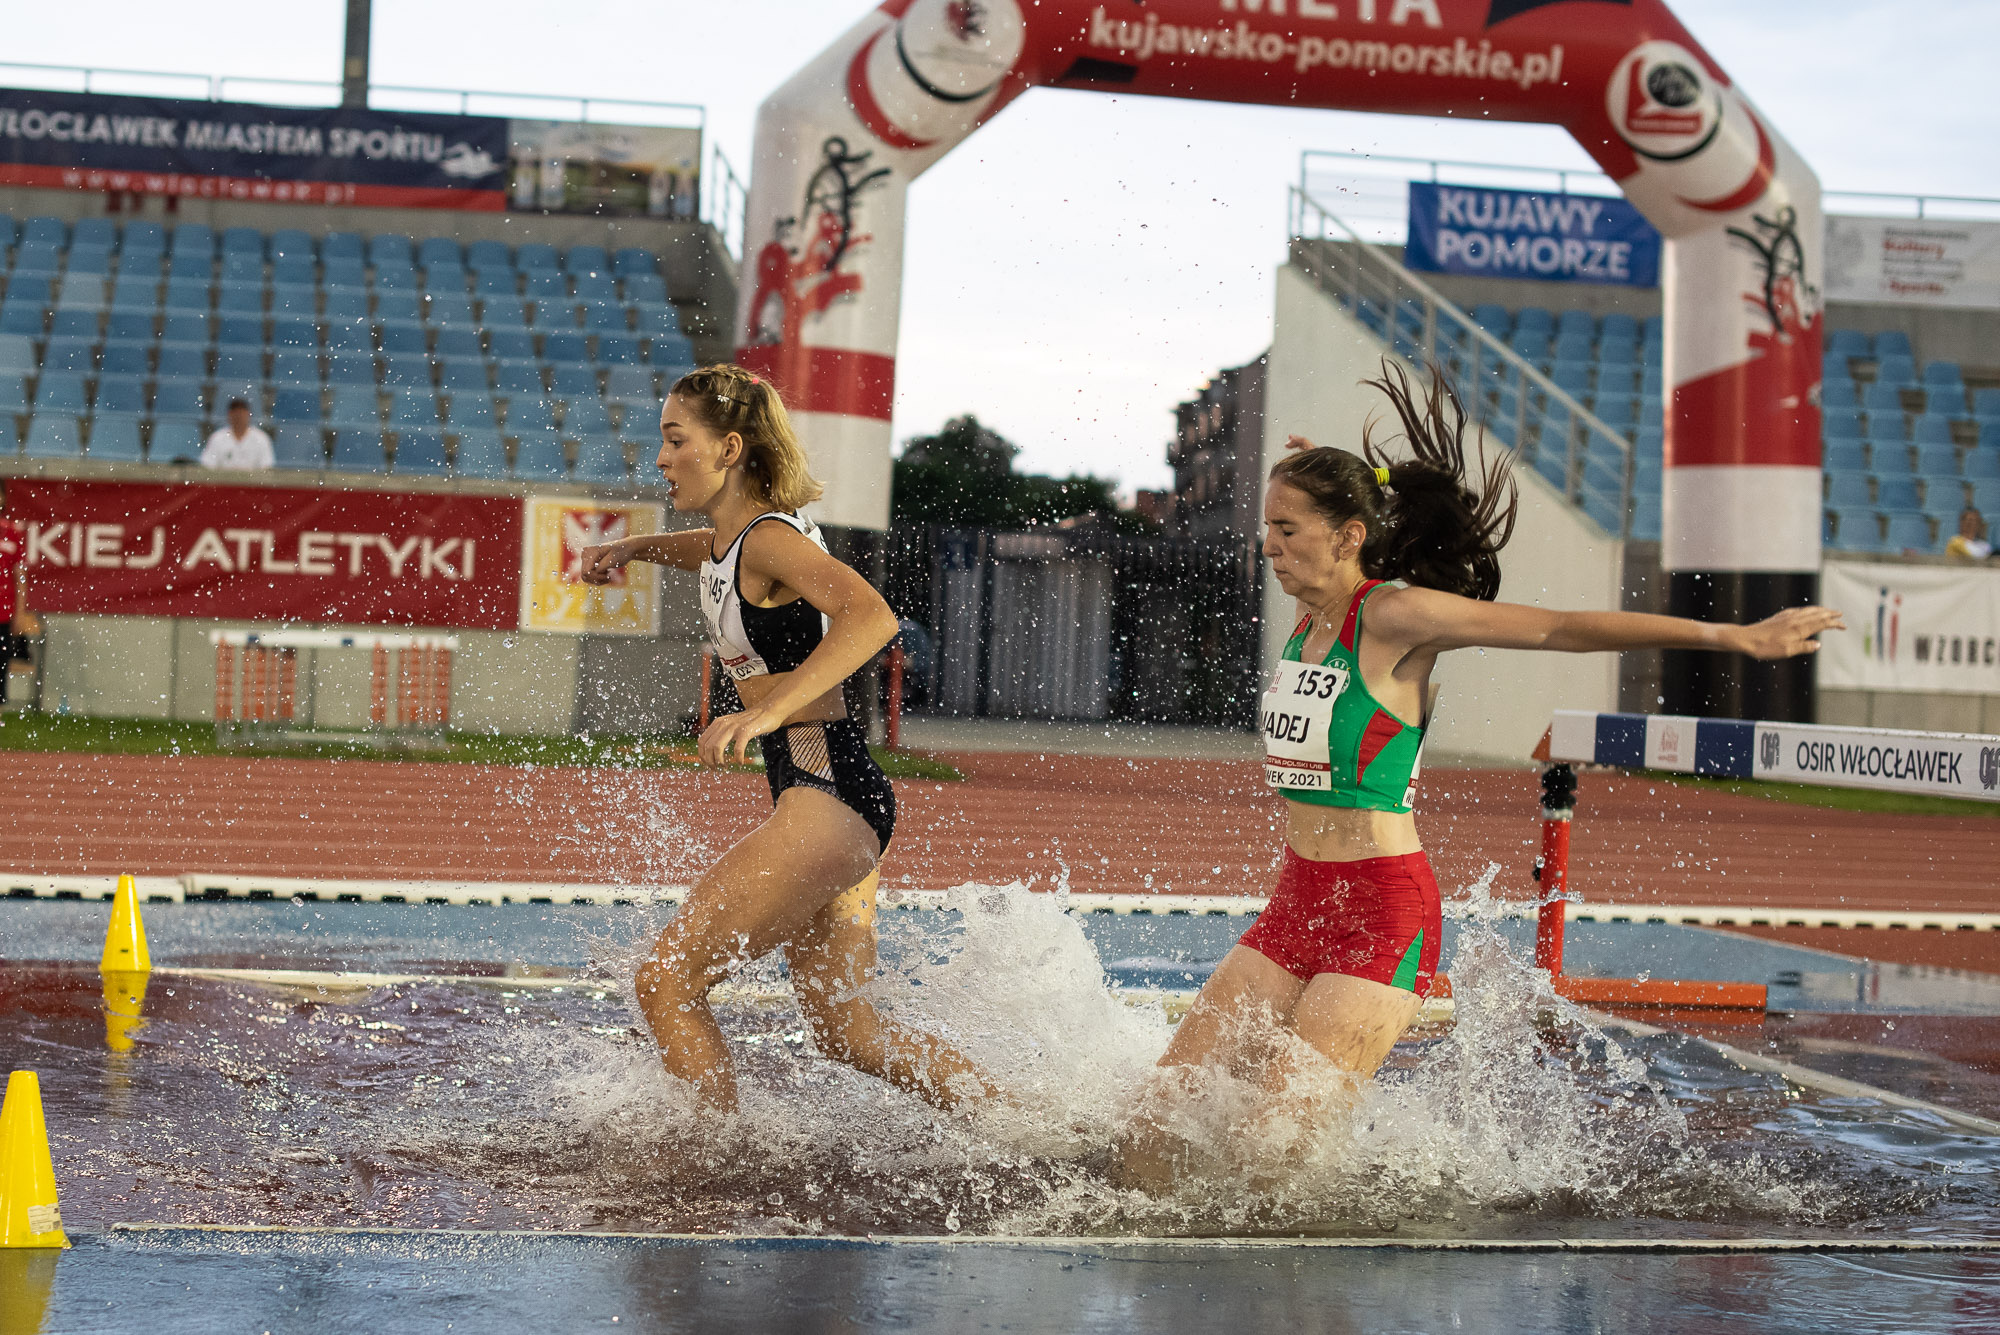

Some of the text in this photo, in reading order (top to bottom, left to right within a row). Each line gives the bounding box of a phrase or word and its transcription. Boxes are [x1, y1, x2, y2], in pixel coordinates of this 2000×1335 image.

[1089, 5, 1565, 91] kujawsko-pomorskie.pl
[183, 120, 324, 156] MIASTEM
[328, 126, 445, 164] SPORTU
[1438, 186, 1603, 236] KUJAWY
[1436, 228, 1633, 279] POMORZE
[14, 519, 476, 581] KIEJ ATLETYKI
[1293, 669, 1337, 699] 153
[1289, 772, 1323, 787] 2021
[1796, 741, 1836, 773] OSIR
[1840, 743, 1964, 785] WŁOCŁAWEK
